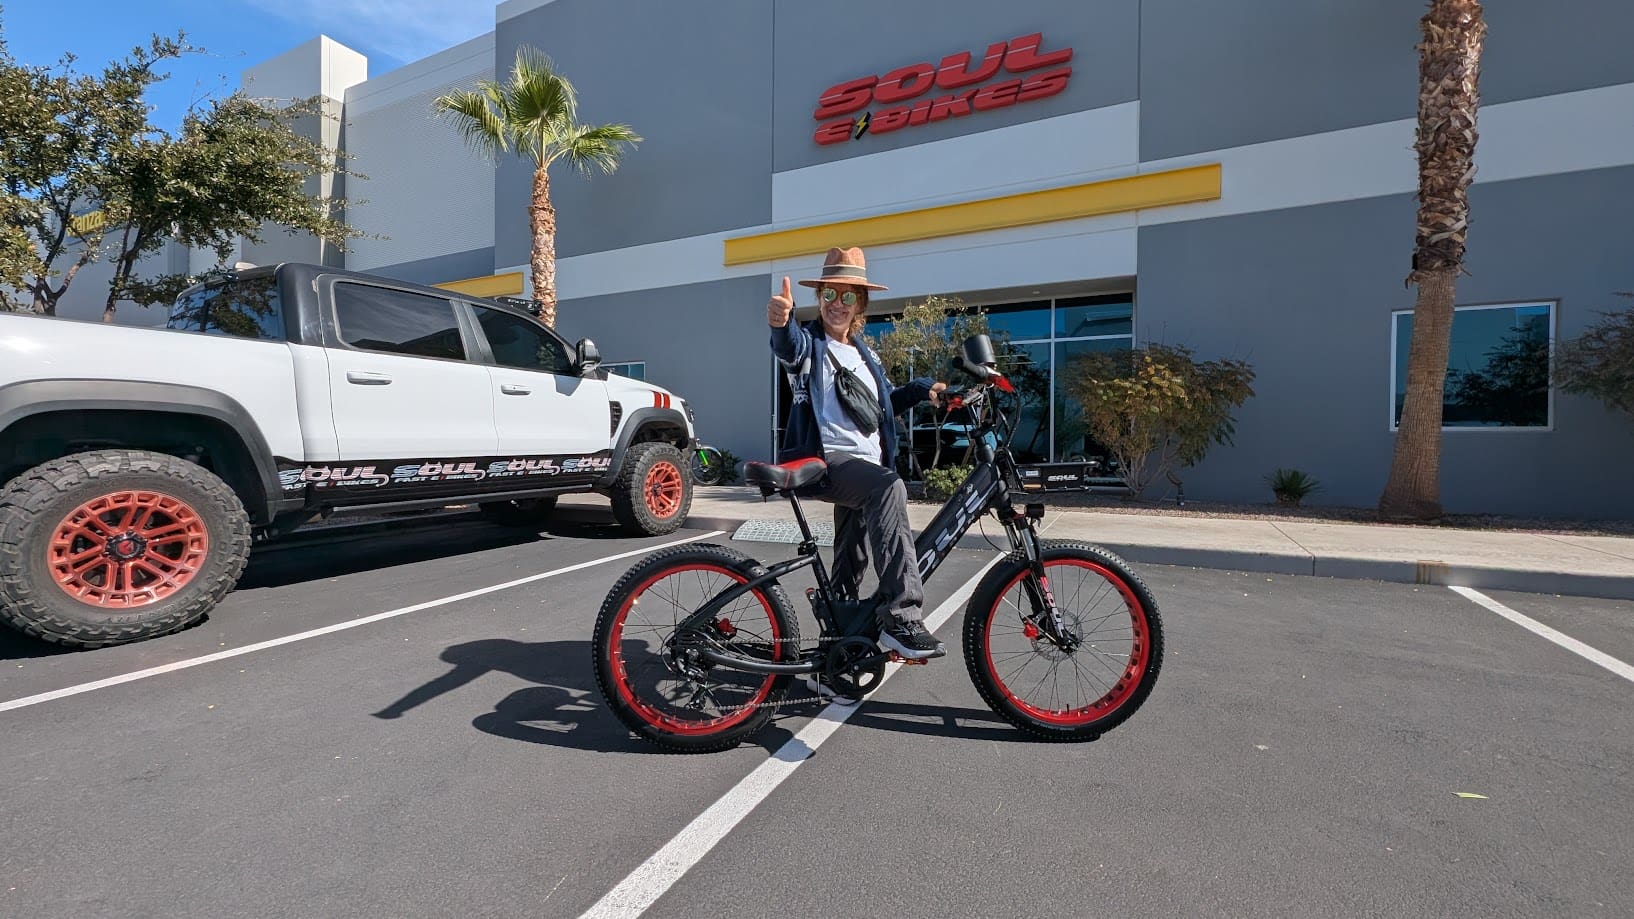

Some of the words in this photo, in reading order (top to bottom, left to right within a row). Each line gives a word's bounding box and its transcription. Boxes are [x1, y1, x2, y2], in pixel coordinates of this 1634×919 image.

[814, 32, 1073, 120] SOUL
[870, 67, 1072, 135] BIKES
[278, 465, 389, 487] SOUL
[391, 462, 486, 481] SOUL
[487, 459, 560, 476] SOUL
[917, 479, 998, 578] OUL
